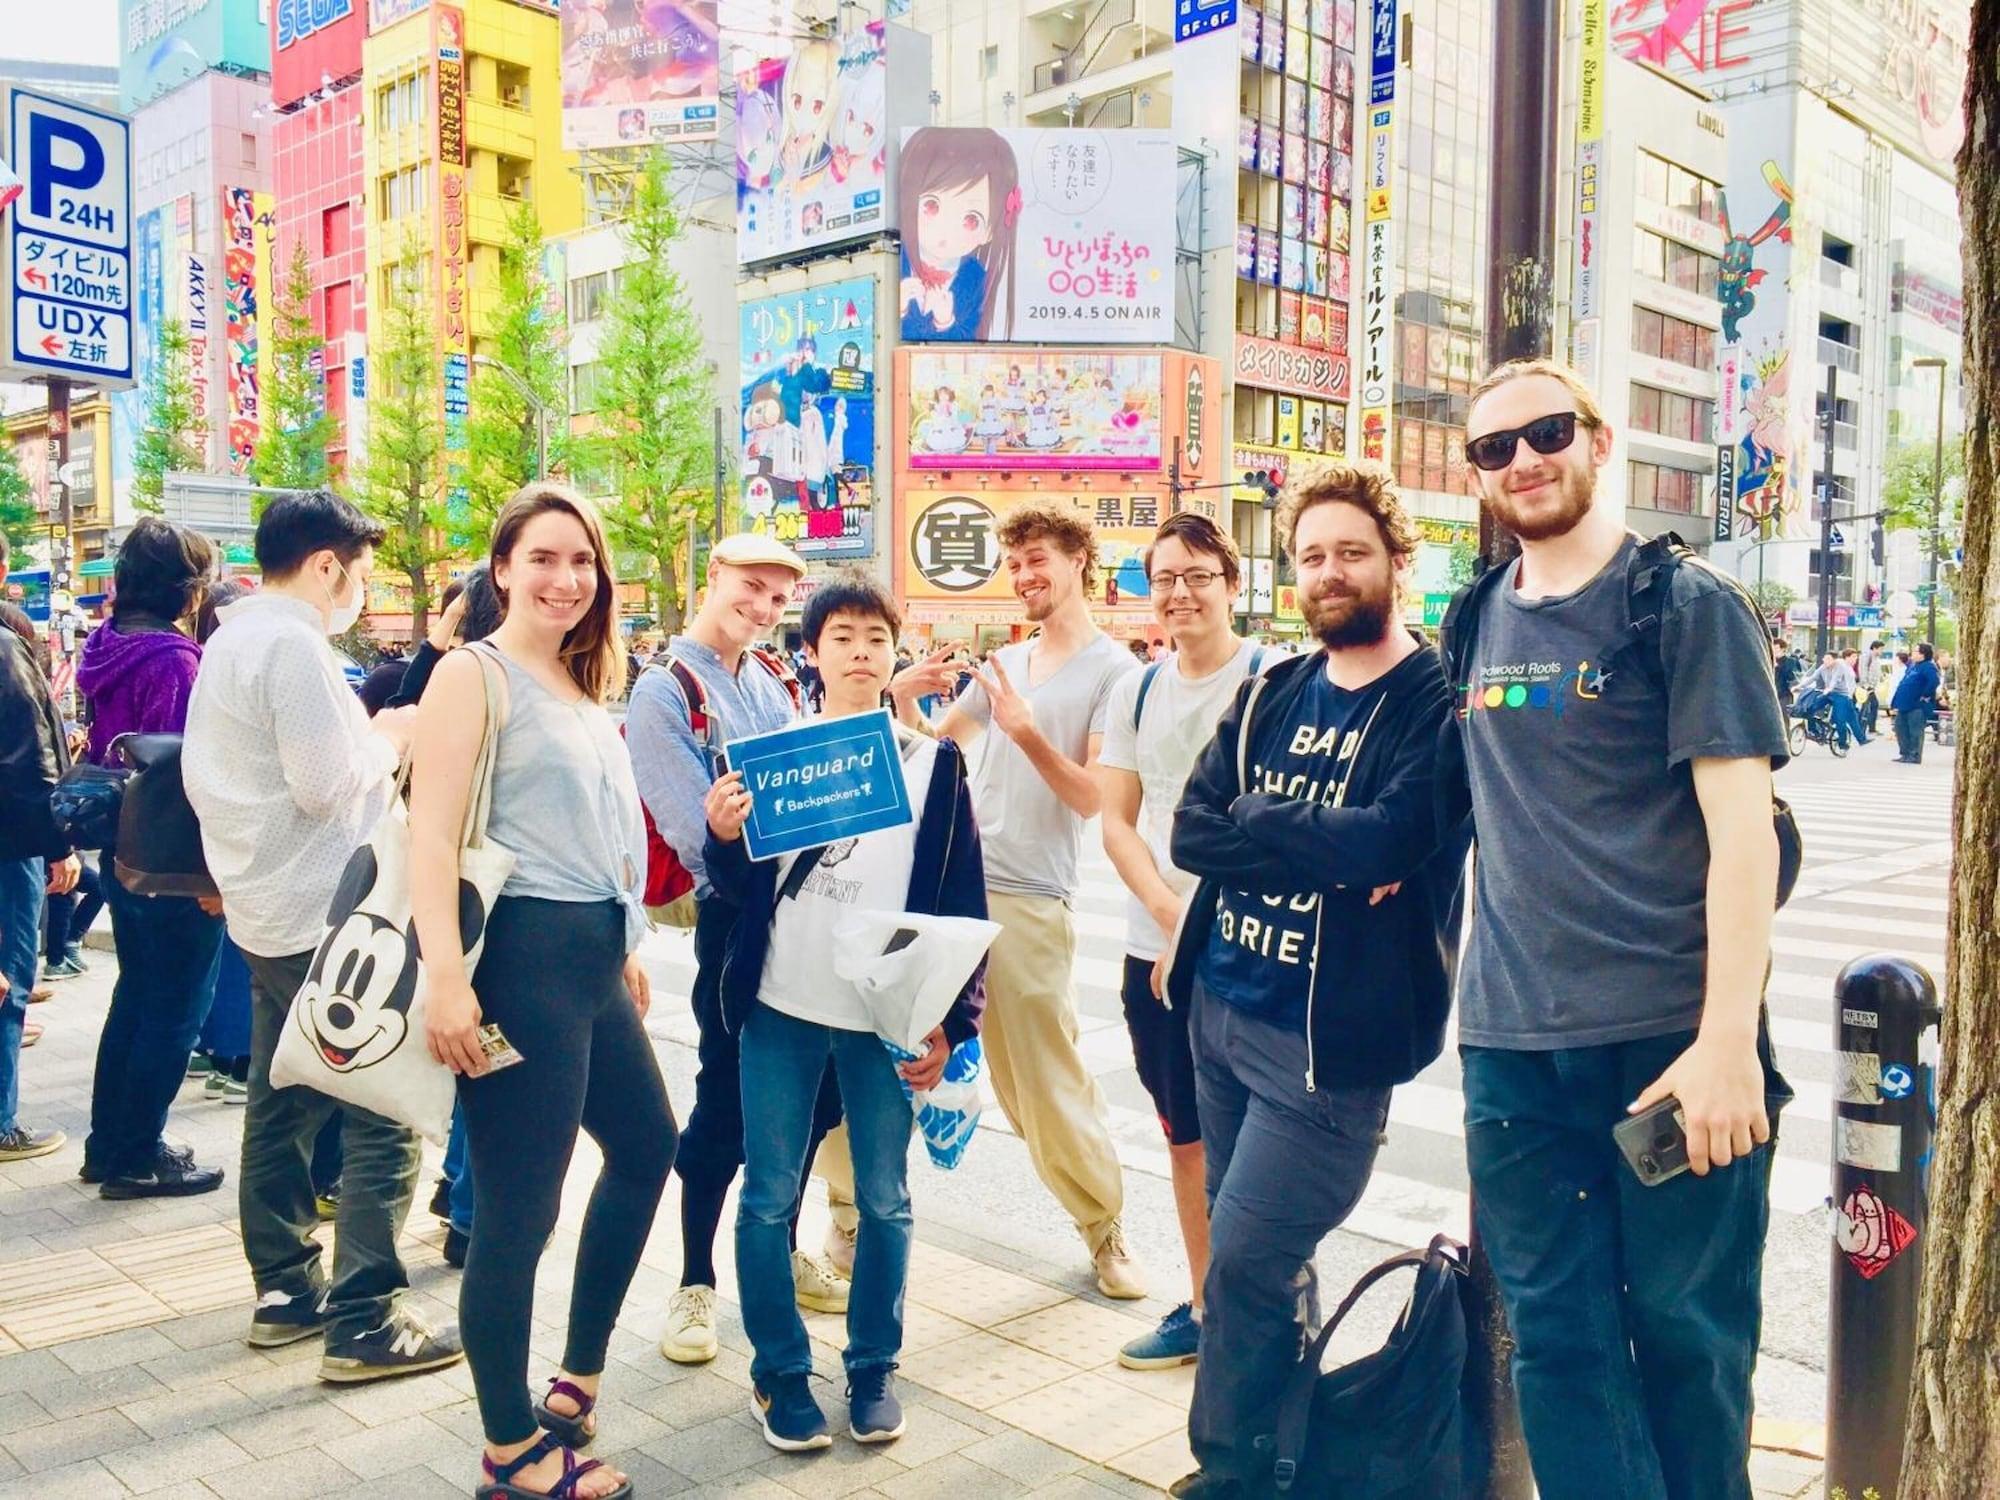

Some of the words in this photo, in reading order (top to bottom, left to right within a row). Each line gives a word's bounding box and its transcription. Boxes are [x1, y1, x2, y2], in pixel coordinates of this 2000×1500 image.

[1375, 114, 1390, 125] 3F
[30, 112, 105, 219] P
[1065, 144, 1079, 200] なりたい
[1082, 144, 1096, 188] 友達に
[59, 199, 114, 233] 24H
[25, 240, 119, 279] ダイビル
[1043, 231, 1150, 270] ひとりぼっちの
[51, 272, 122, 305] 120m先
[38, 304, 107, 339] UDX
[1029, 305, 1099, 320] 2019.4.5
[1104, 305, 1130, 319] ON
[1133, 305, 1162, 319] AIR
[69, 338, 107, 363] 左折
[1239, 344, 1345, 390] メイドカジノ
[1717, 449, 1732, 537] GALLERIA
[922, 511, 993, 579] 質
[1528, 662, 1561, 675] Roots
[1288, 724, 1360, 763] BAD
[756, 745, 874, 791] Vanguard
[787, 785, 861, 812] Backpackers
